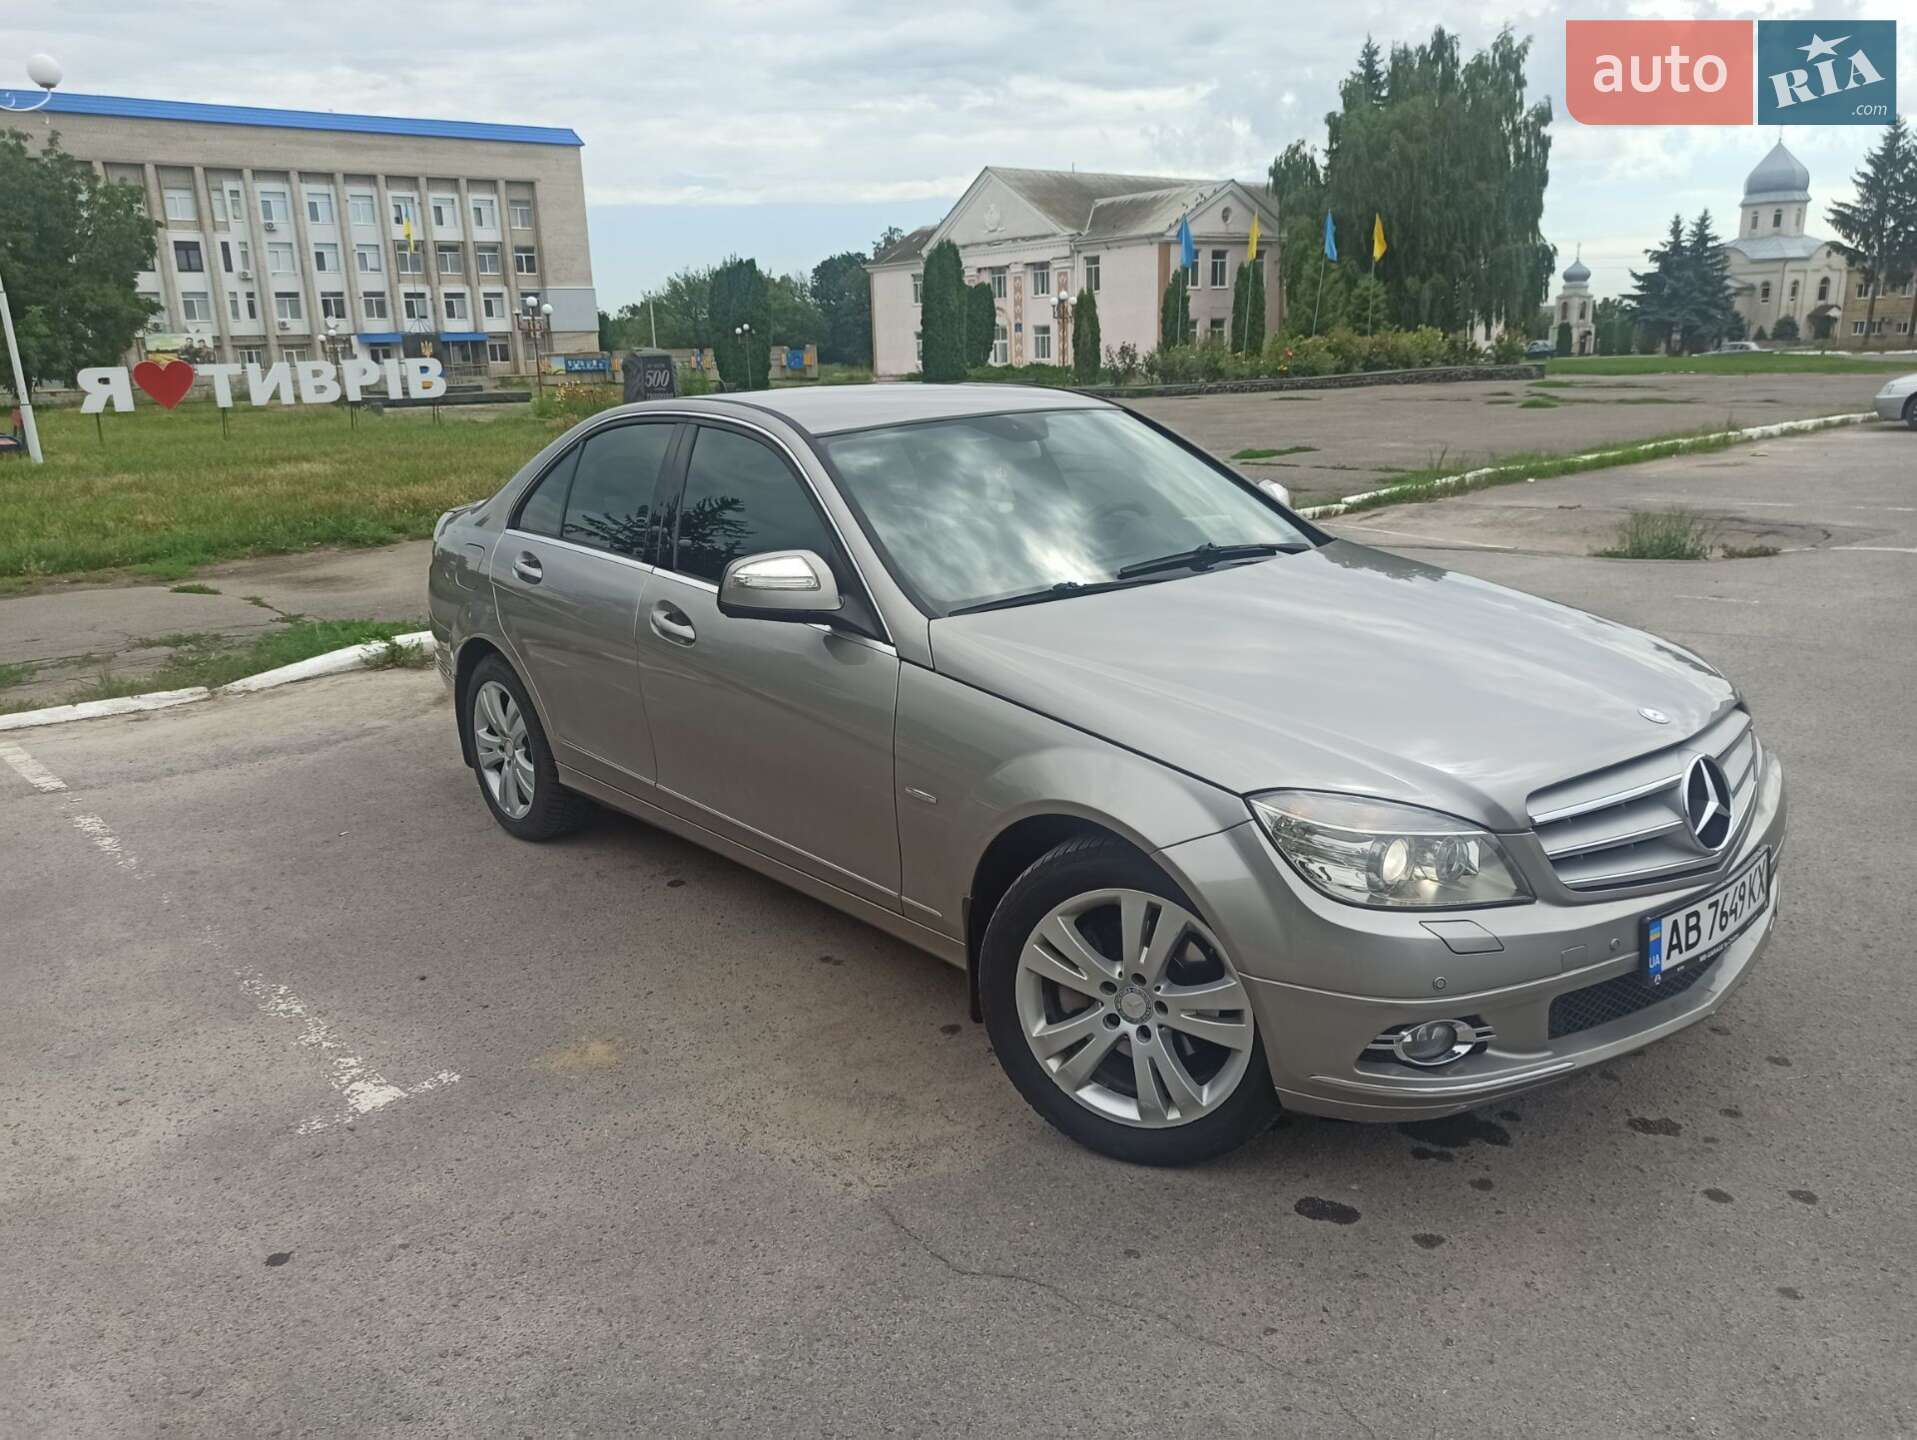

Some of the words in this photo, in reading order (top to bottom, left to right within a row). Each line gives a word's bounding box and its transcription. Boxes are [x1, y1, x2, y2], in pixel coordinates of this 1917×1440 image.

[77, 366, 136, 414] Я
[199, 357, 447, 408] ТИВРІВ
[645, 369, 670, 388] 500
[1666, 909, 1702, 960] AB
[1708, 881, 1746, 941] 7649
[1648, 953, 1661, 969] UA
